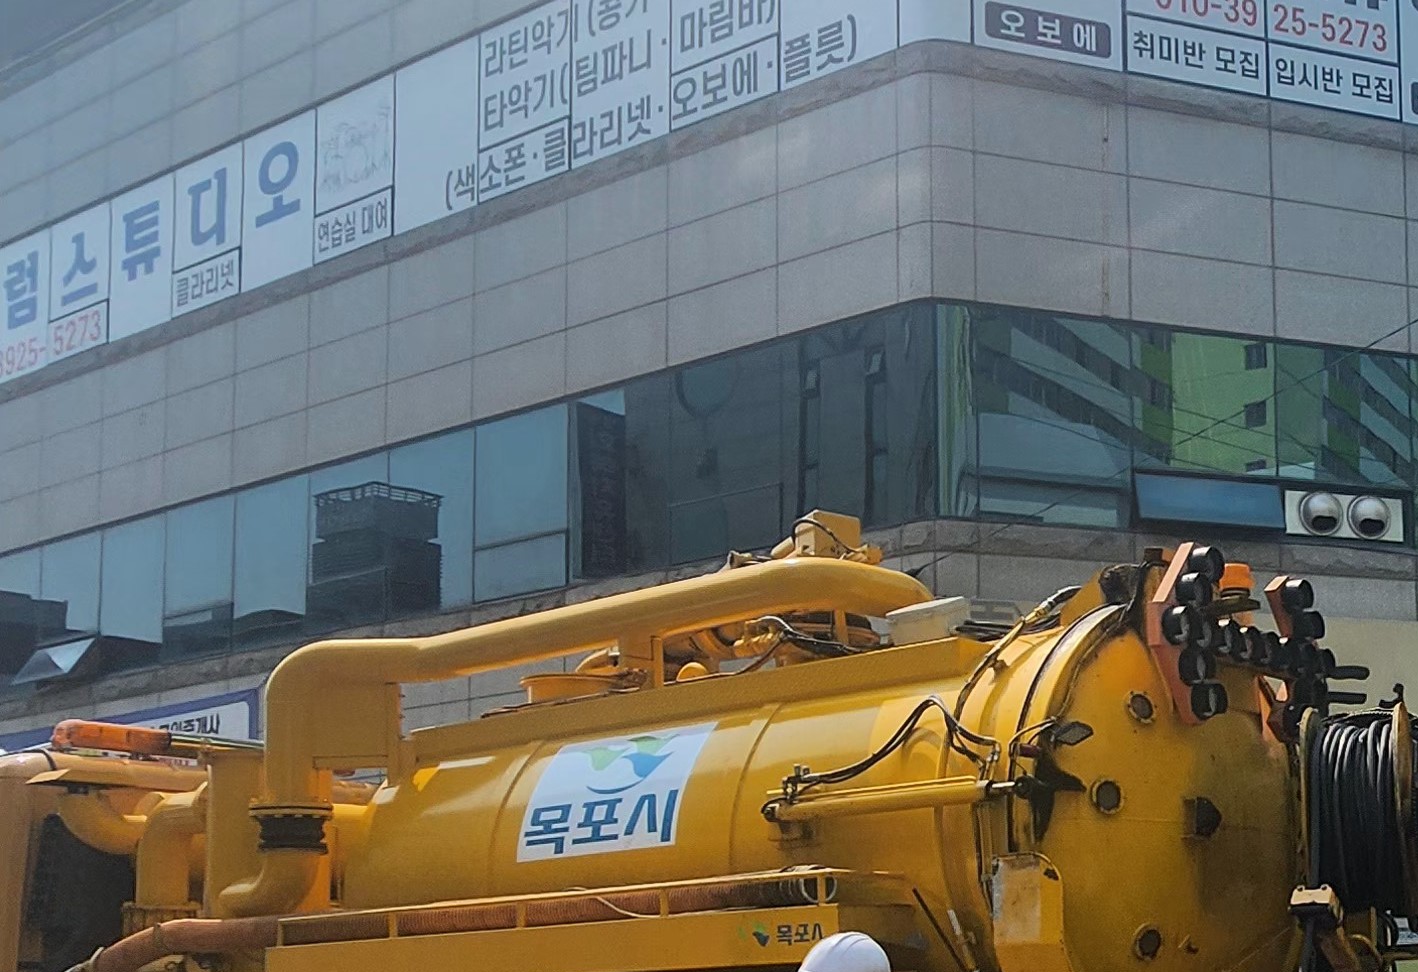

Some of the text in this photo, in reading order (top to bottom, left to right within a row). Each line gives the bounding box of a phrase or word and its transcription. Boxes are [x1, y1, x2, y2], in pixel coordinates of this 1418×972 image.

[1132, 29, 1260, 80] 취미반 모집
[1274, 57, 1394, 104] 입시반 모집
[316, 196, 389, 253] 연습실 대여
[175, 258, 235, 307] 클라리넷
[523, 788, 679, 855] 목포시
